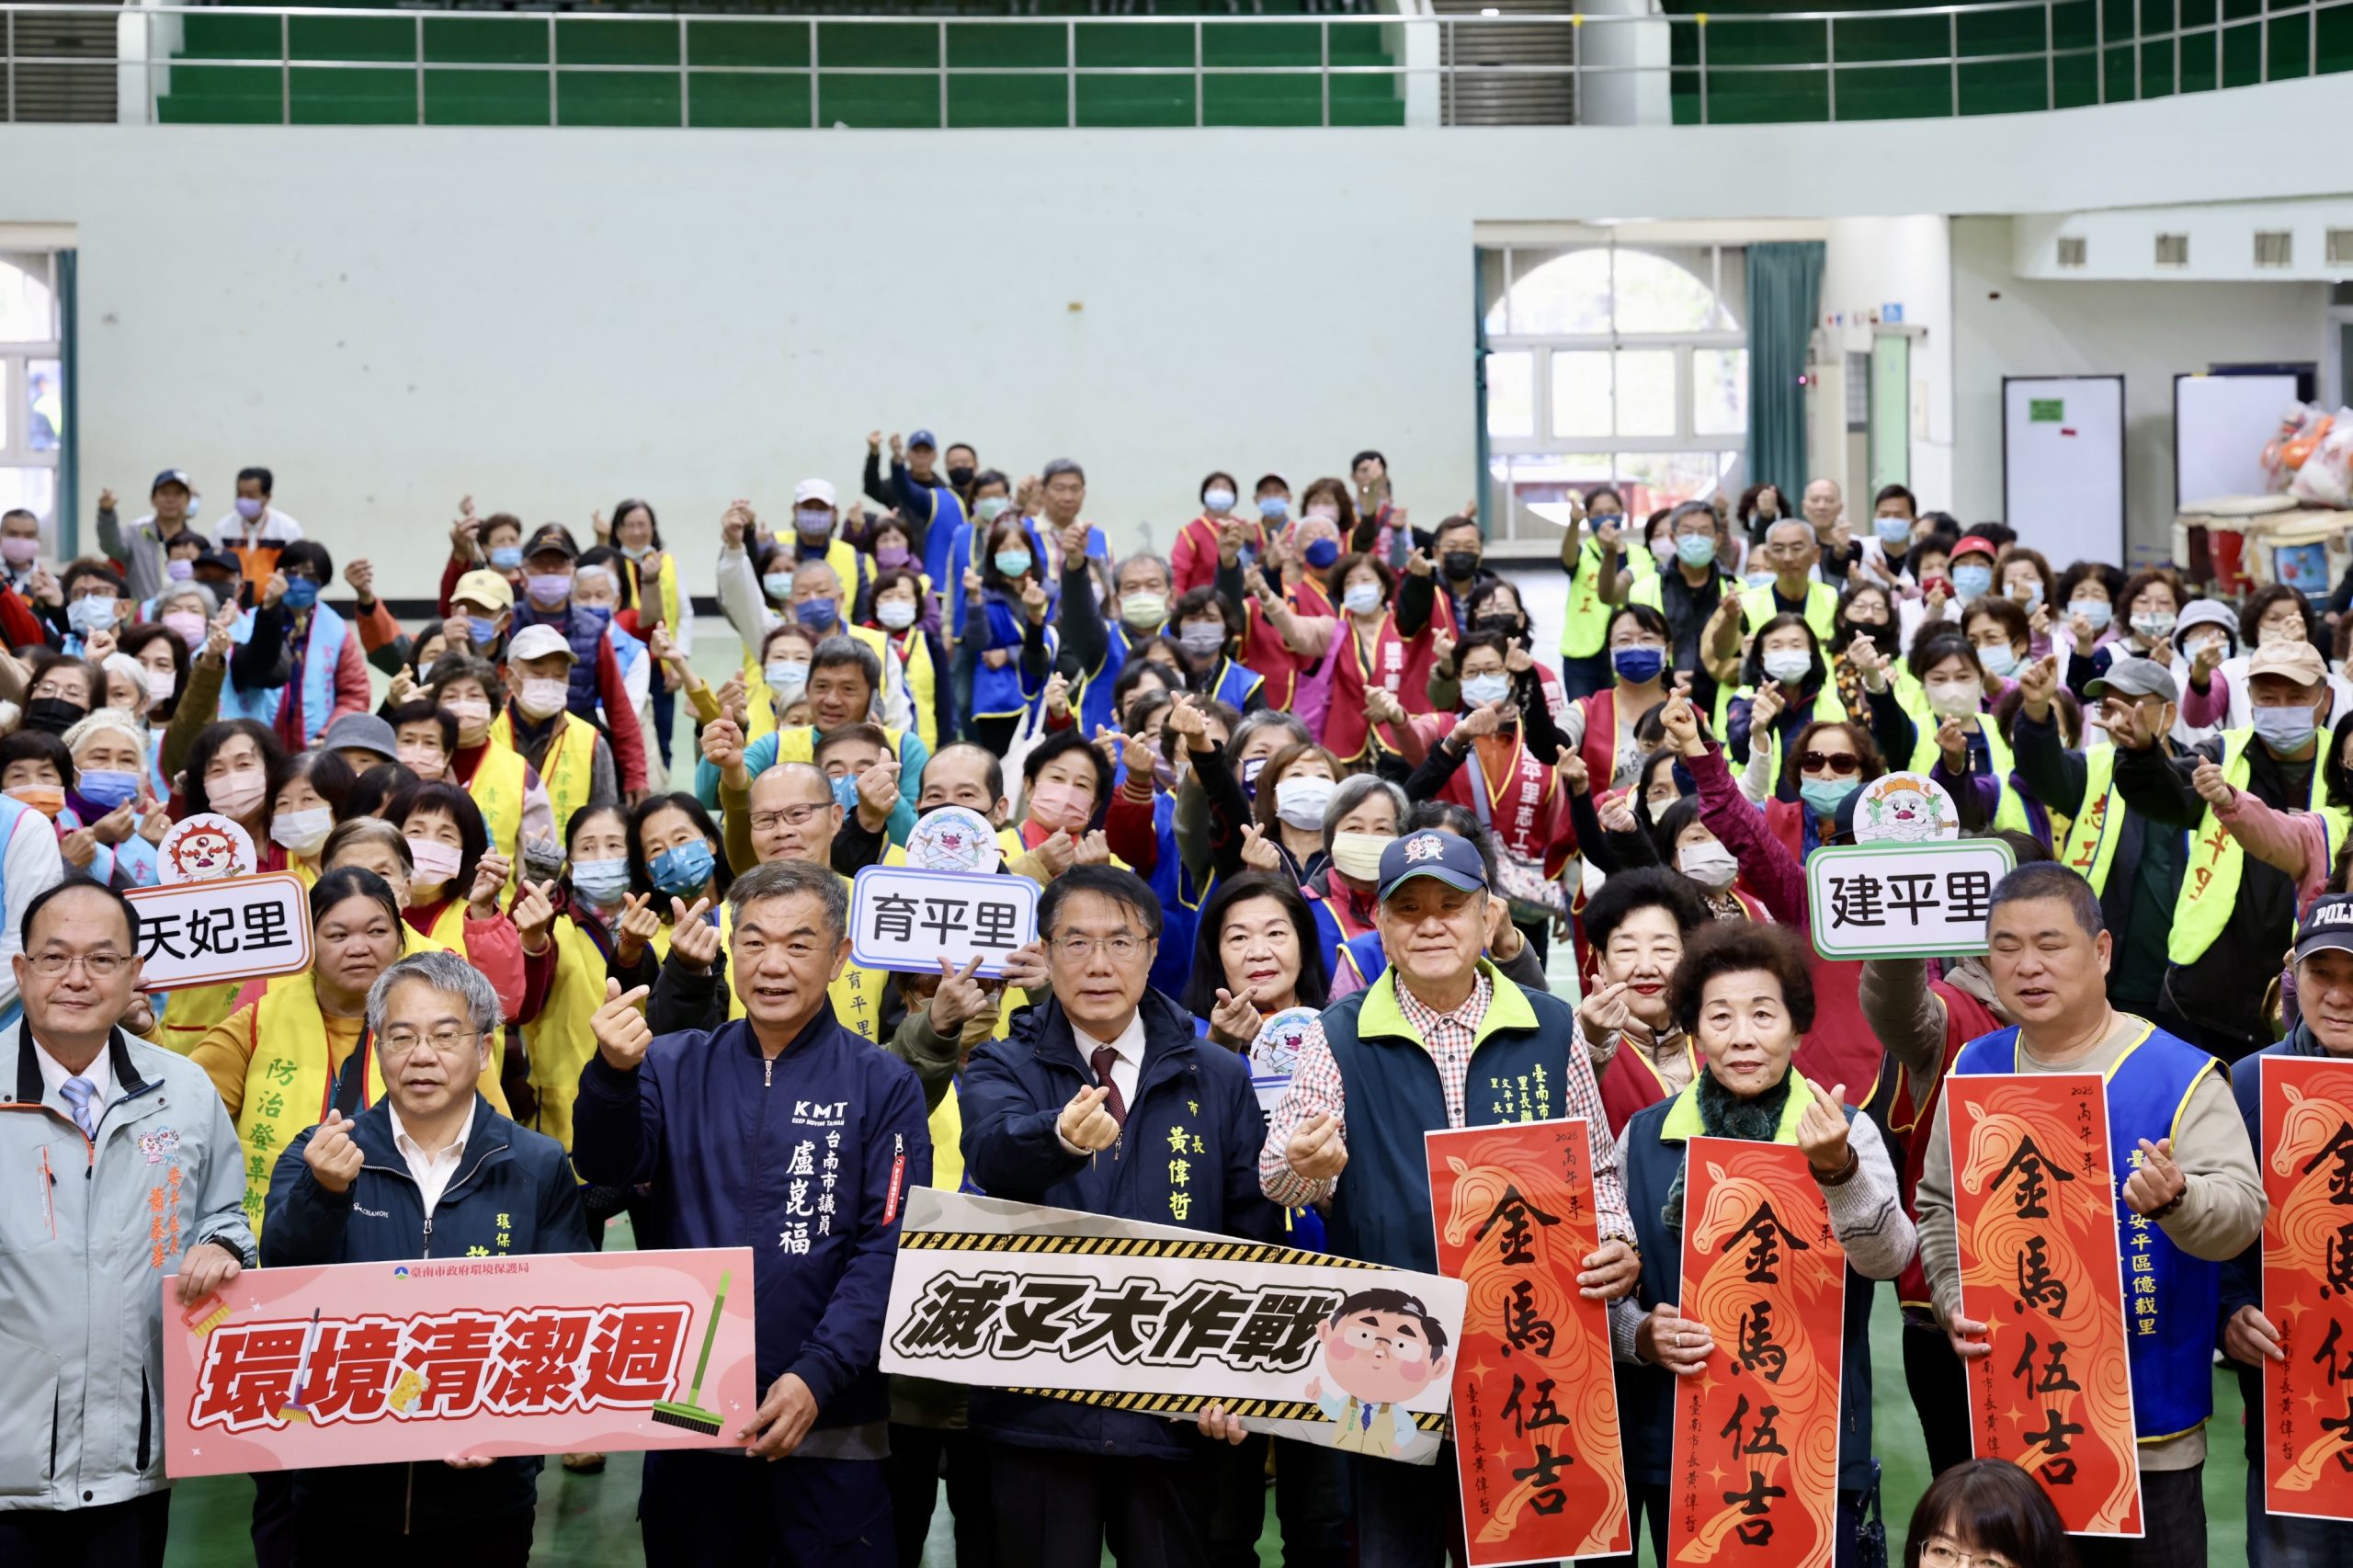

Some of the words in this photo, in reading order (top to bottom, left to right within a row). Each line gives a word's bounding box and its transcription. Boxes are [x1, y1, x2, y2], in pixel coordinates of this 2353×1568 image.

[140, 901, 292, 961] 天妃里
[872, 892, 1017, 949] 育平里
[1829, 871, 1991, 928] 建平里
[846, 971, 872, 1037] 育平里
[243, 1058, 298, 1219] 防治登革熱
[794, 1100, 848, 1119] KMT
[1501, 1078, 1515, 1113] 文平里
[1532, 1063, 1550, 1120] 臺南市
[1555, 1131, 1578, 1142] 2026
[779, 1140, 816, 1256] 盧崑福
[816, 1130, 841, 1237] 台南市議員
[886, 1167, 901, 1217] FIGHTING
[1166, 1126, 1192, 1221] 黃偉哲
[410, 1262, 529, 1278] 臺南市政府環境保護局
[2126, 1148, 2158, 1336] 臺安平區億載里
[1475, 1184, 1574, 1516] 金馬伍吉
[1990, 1134, 2085, 1486] 金馬伍吉
[191, 1305, 690, 1429] 環境清潔週
[1720, 1200, 1810, 1547] 金馬伍吉
[1982, 1337, 2002, 1455] 南市長黃偉
[1685, 1394, 1703, 1534] 臺南市長黃偉哲
